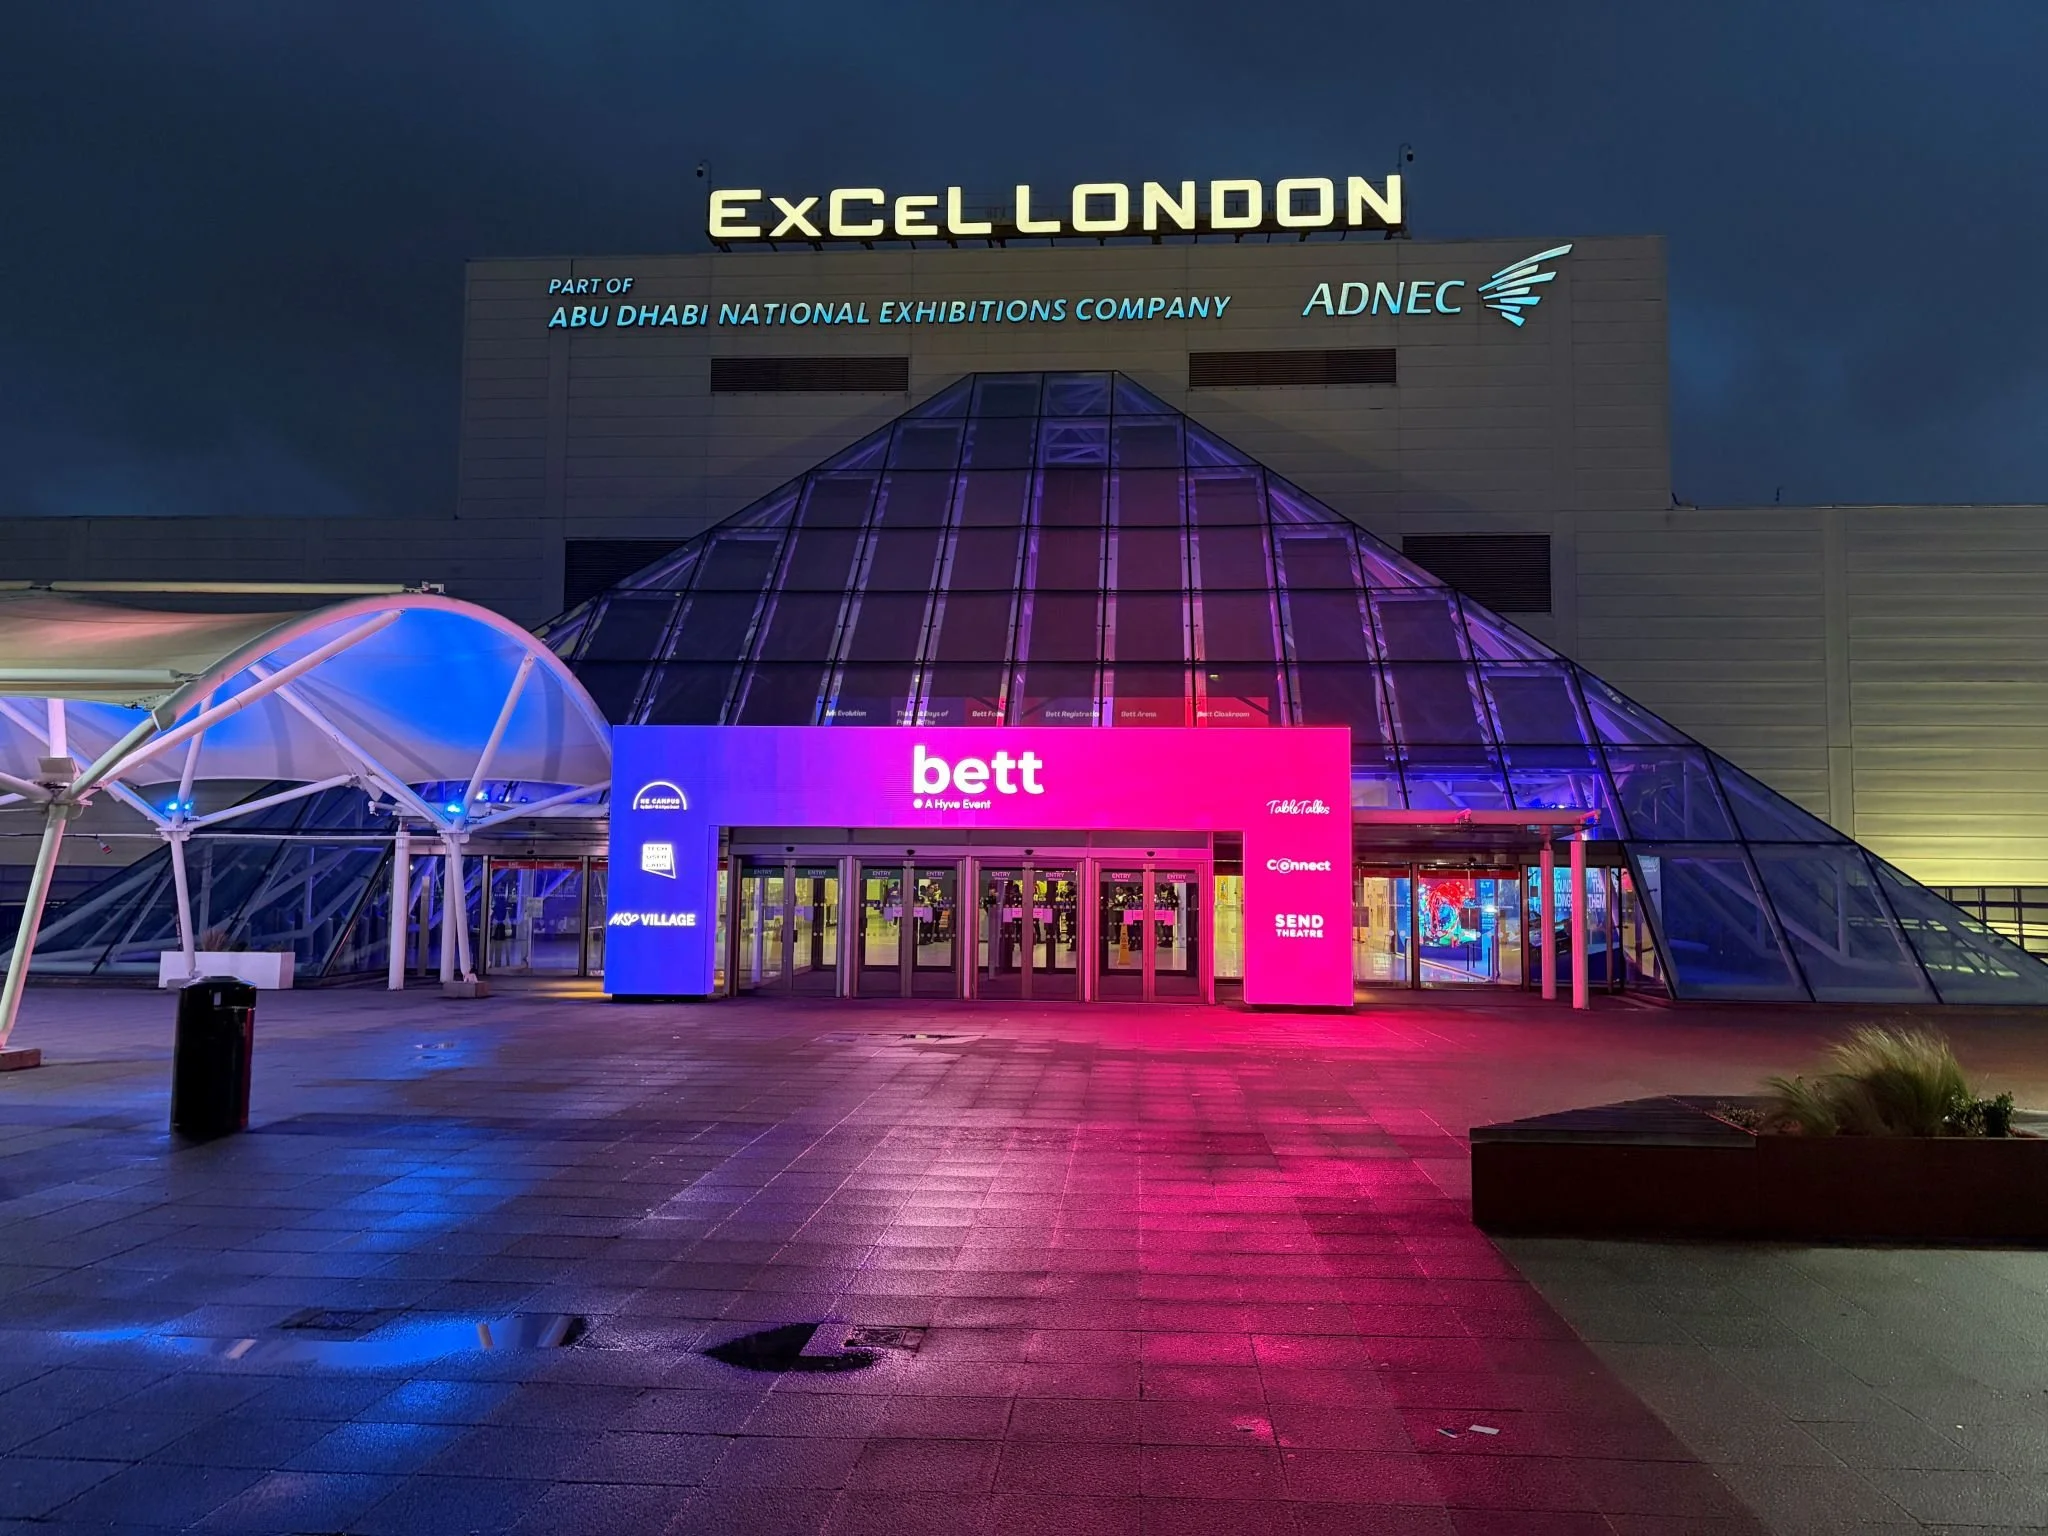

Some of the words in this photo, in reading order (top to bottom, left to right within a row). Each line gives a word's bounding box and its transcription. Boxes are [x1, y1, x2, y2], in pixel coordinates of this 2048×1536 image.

[1015, 174, 1402, 234] LONDON
[549, 278, 602, 294] PART
[606, 277, 634, 293] OF
[1302, 280, 1465, 316] ADNEC
[548, 305, 608, 328] ABU
[616, 304, 709, 327] DHABI
[718, 302, 870, 326] NATIONAL
[879, 299, 1067, 323] EXHIBITIONS
[1075, 296, 1232, 321] COMPANY
[913, 744, 1045, 795] bett
[924, 799, 934, 809] A
[934, 799, 961, 812] Hyve
[962, 799, 991, 810] Event
[1266, 857, 1332, 874] Connect
[640, 912, 697, 927] VILLAGE
[1275, 914, 1324, 929] SEND
[1276, 928, 1324, 938] THEATRE
